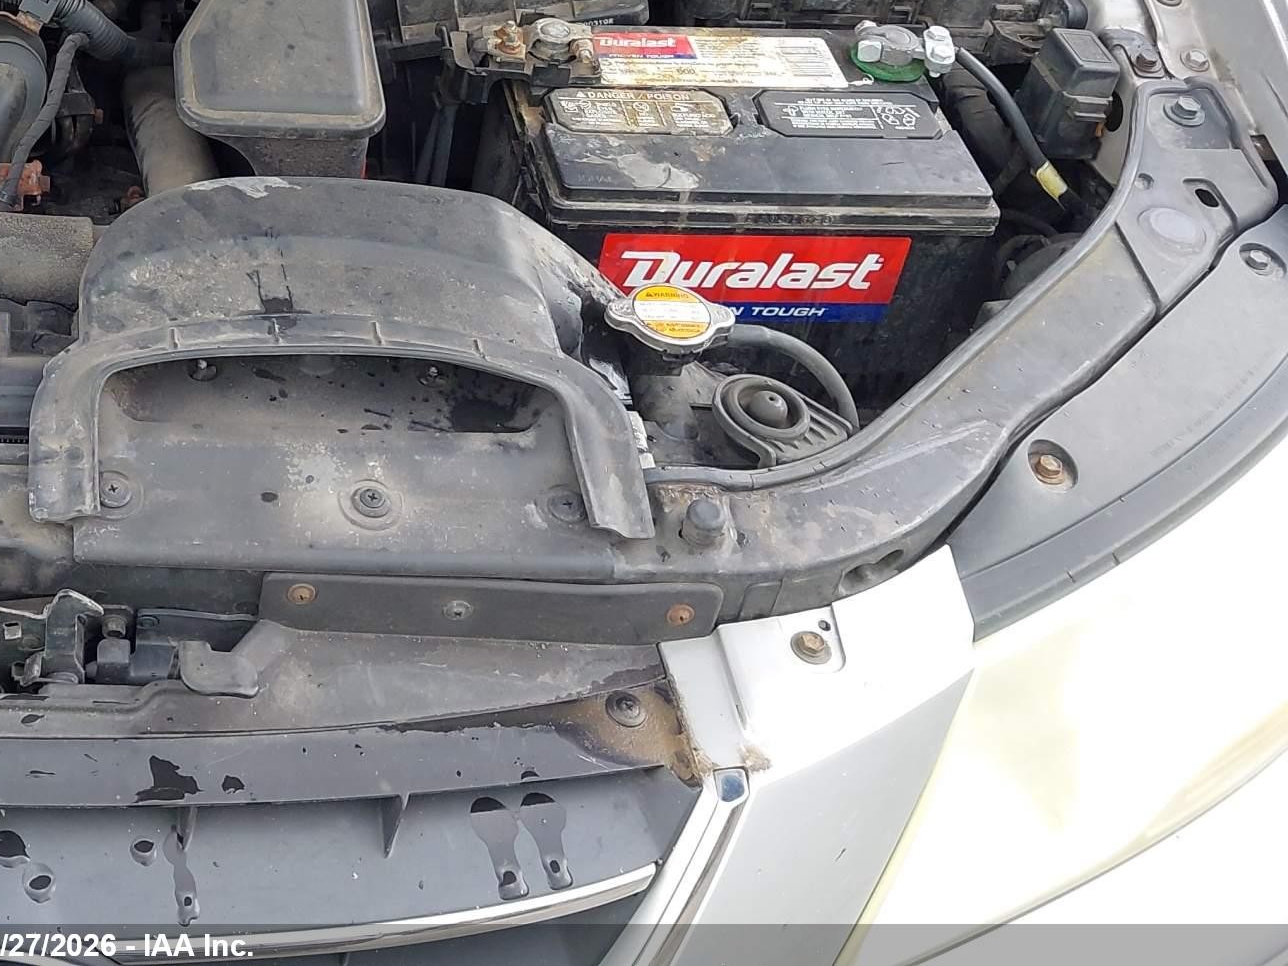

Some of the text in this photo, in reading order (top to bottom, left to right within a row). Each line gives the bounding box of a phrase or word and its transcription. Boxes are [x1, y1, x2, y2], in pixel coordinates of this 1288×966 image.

[594, 37, 677, 48] Duralast
[587, 91, 636, 100] DANGER
[647, 93, 690, 101] POISON
[621, 249, 884, 290] Duralast
[751, 306, 829, 316] TOUGH
